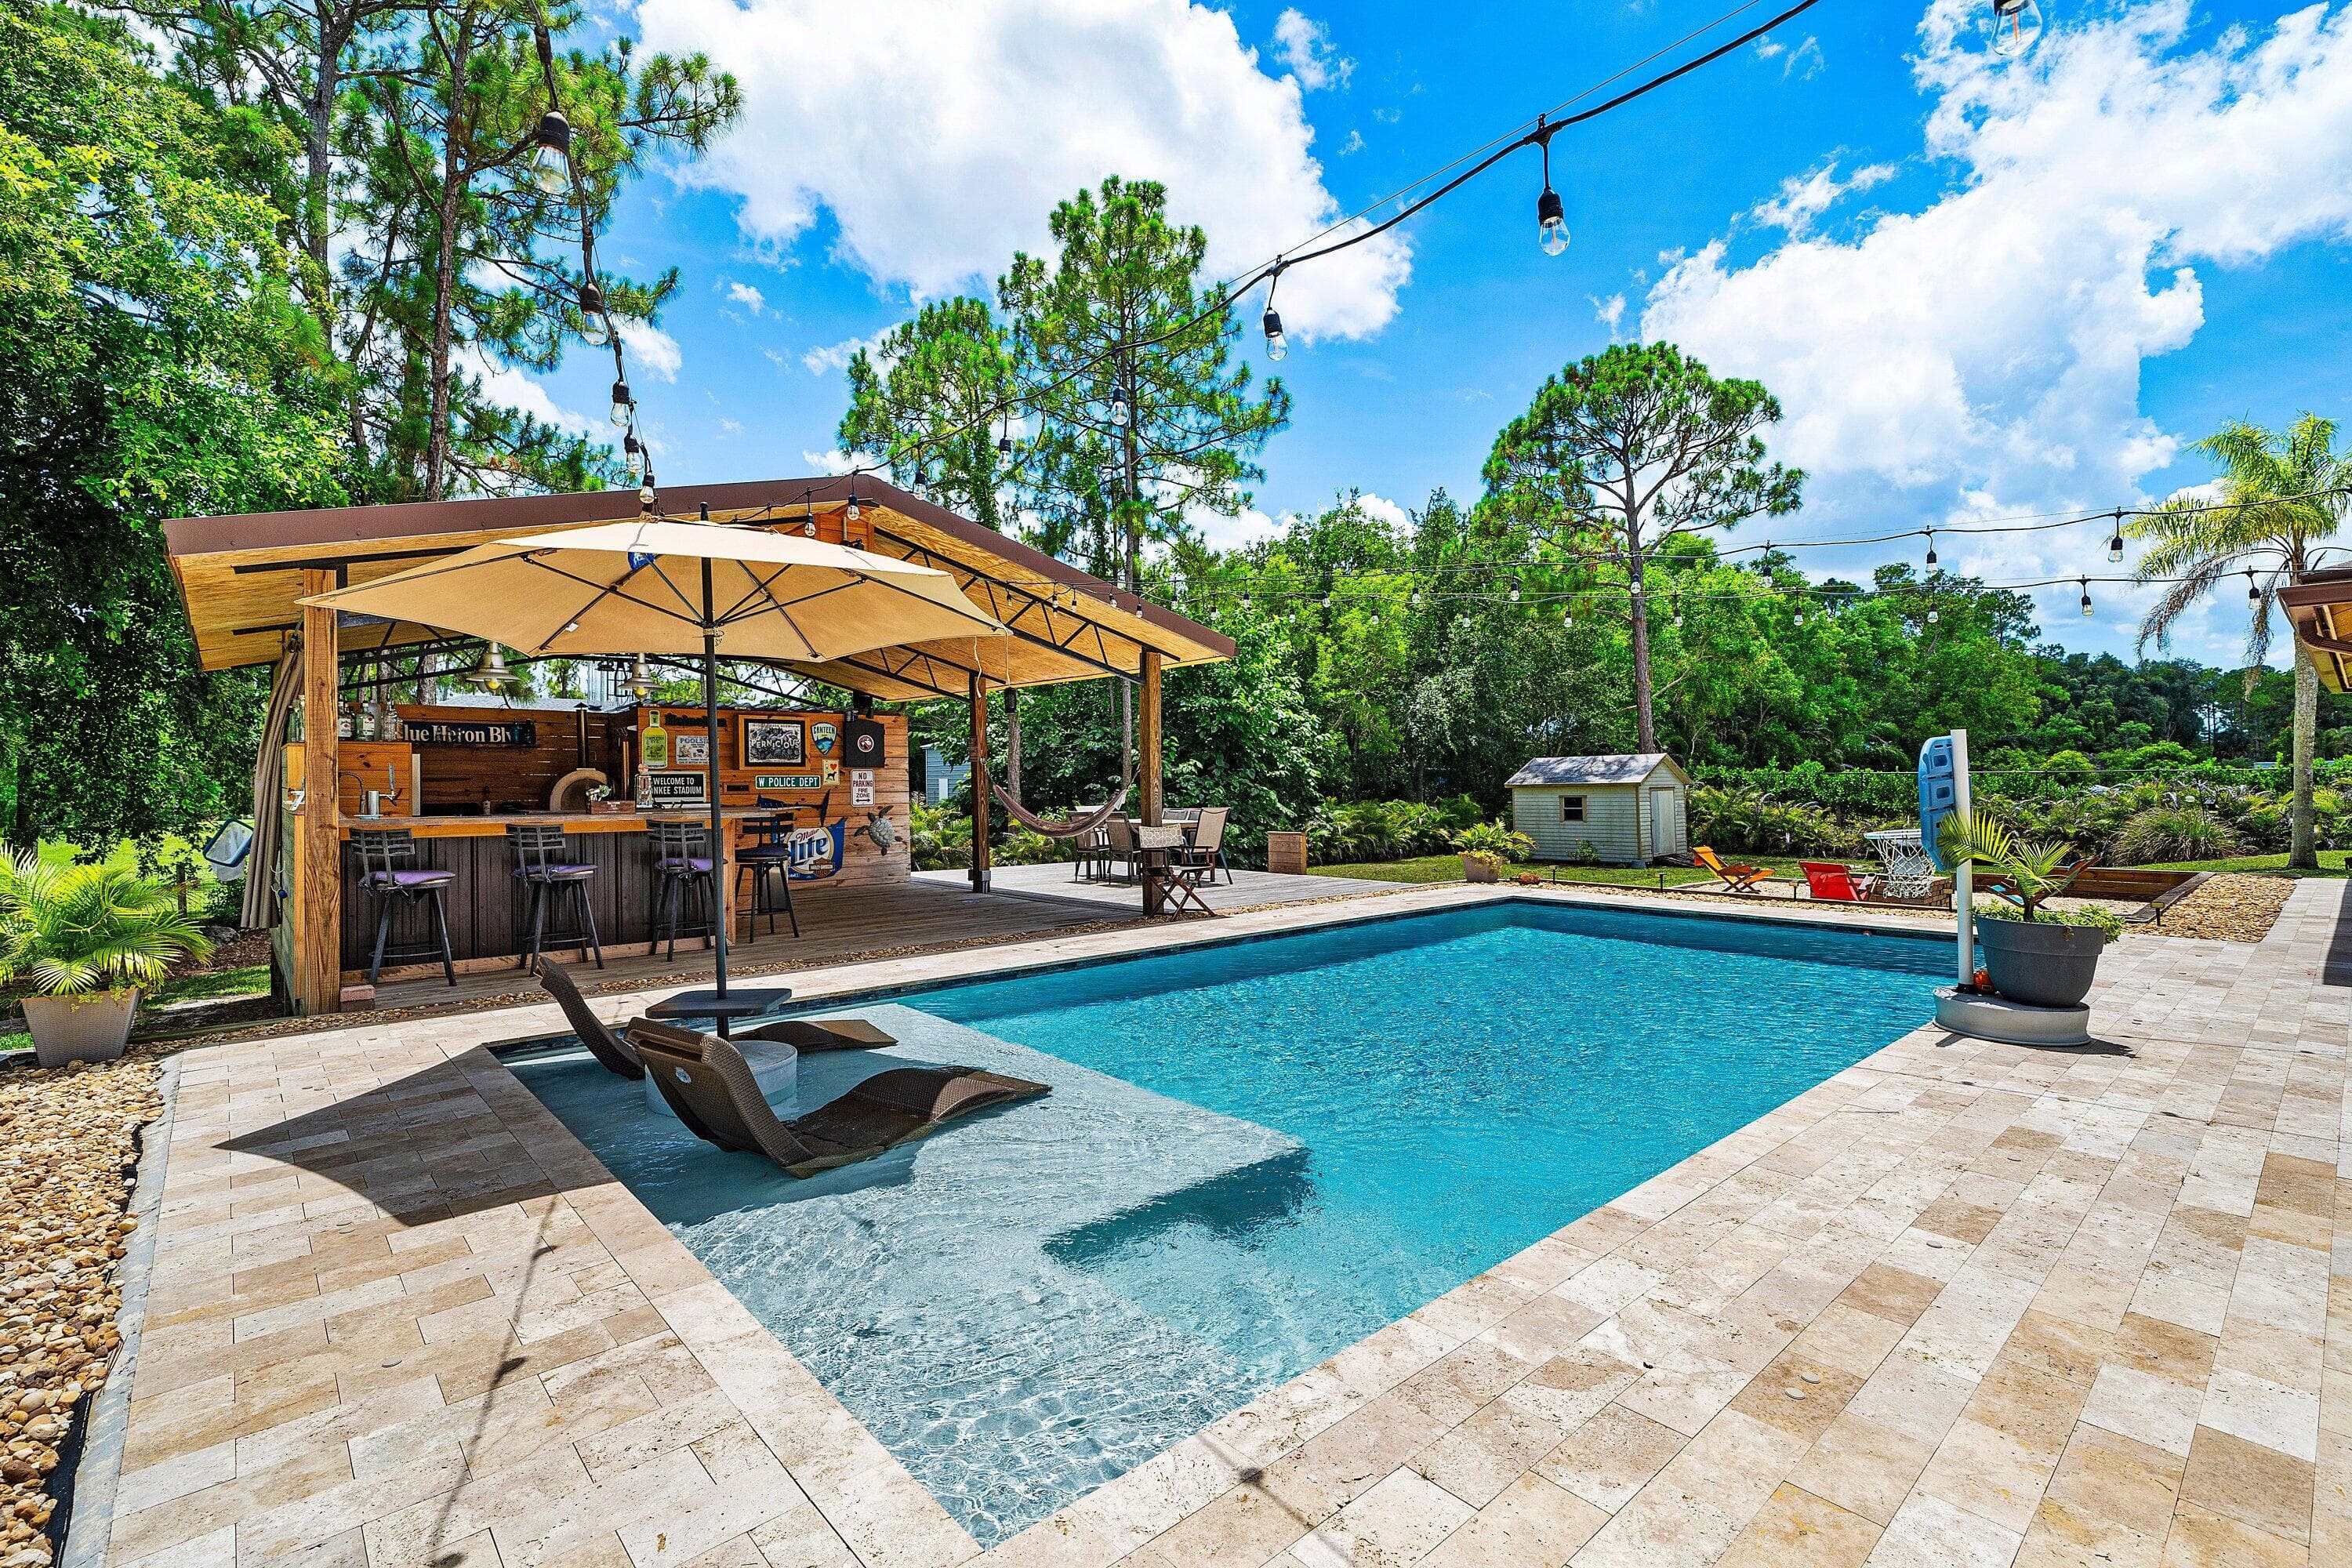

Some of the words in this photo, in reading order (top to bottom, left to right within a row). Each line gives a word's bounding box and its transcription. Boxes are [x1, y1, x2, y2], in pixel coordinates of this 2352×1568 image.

[403, 724, 430, 742] lue
[488, 726, 511, 742] Blv
[751, 739, 799, 750] PERNICIOUS
[758, 777, 765, 787] W
[768, 777, 796, 787] POLICE
[800, 777, 818, 787] DEPT
[651, 786, 671, 795] ANKEE
[796, 829, 820, 842] Miller
[789, 837, 829, 867] Lite
